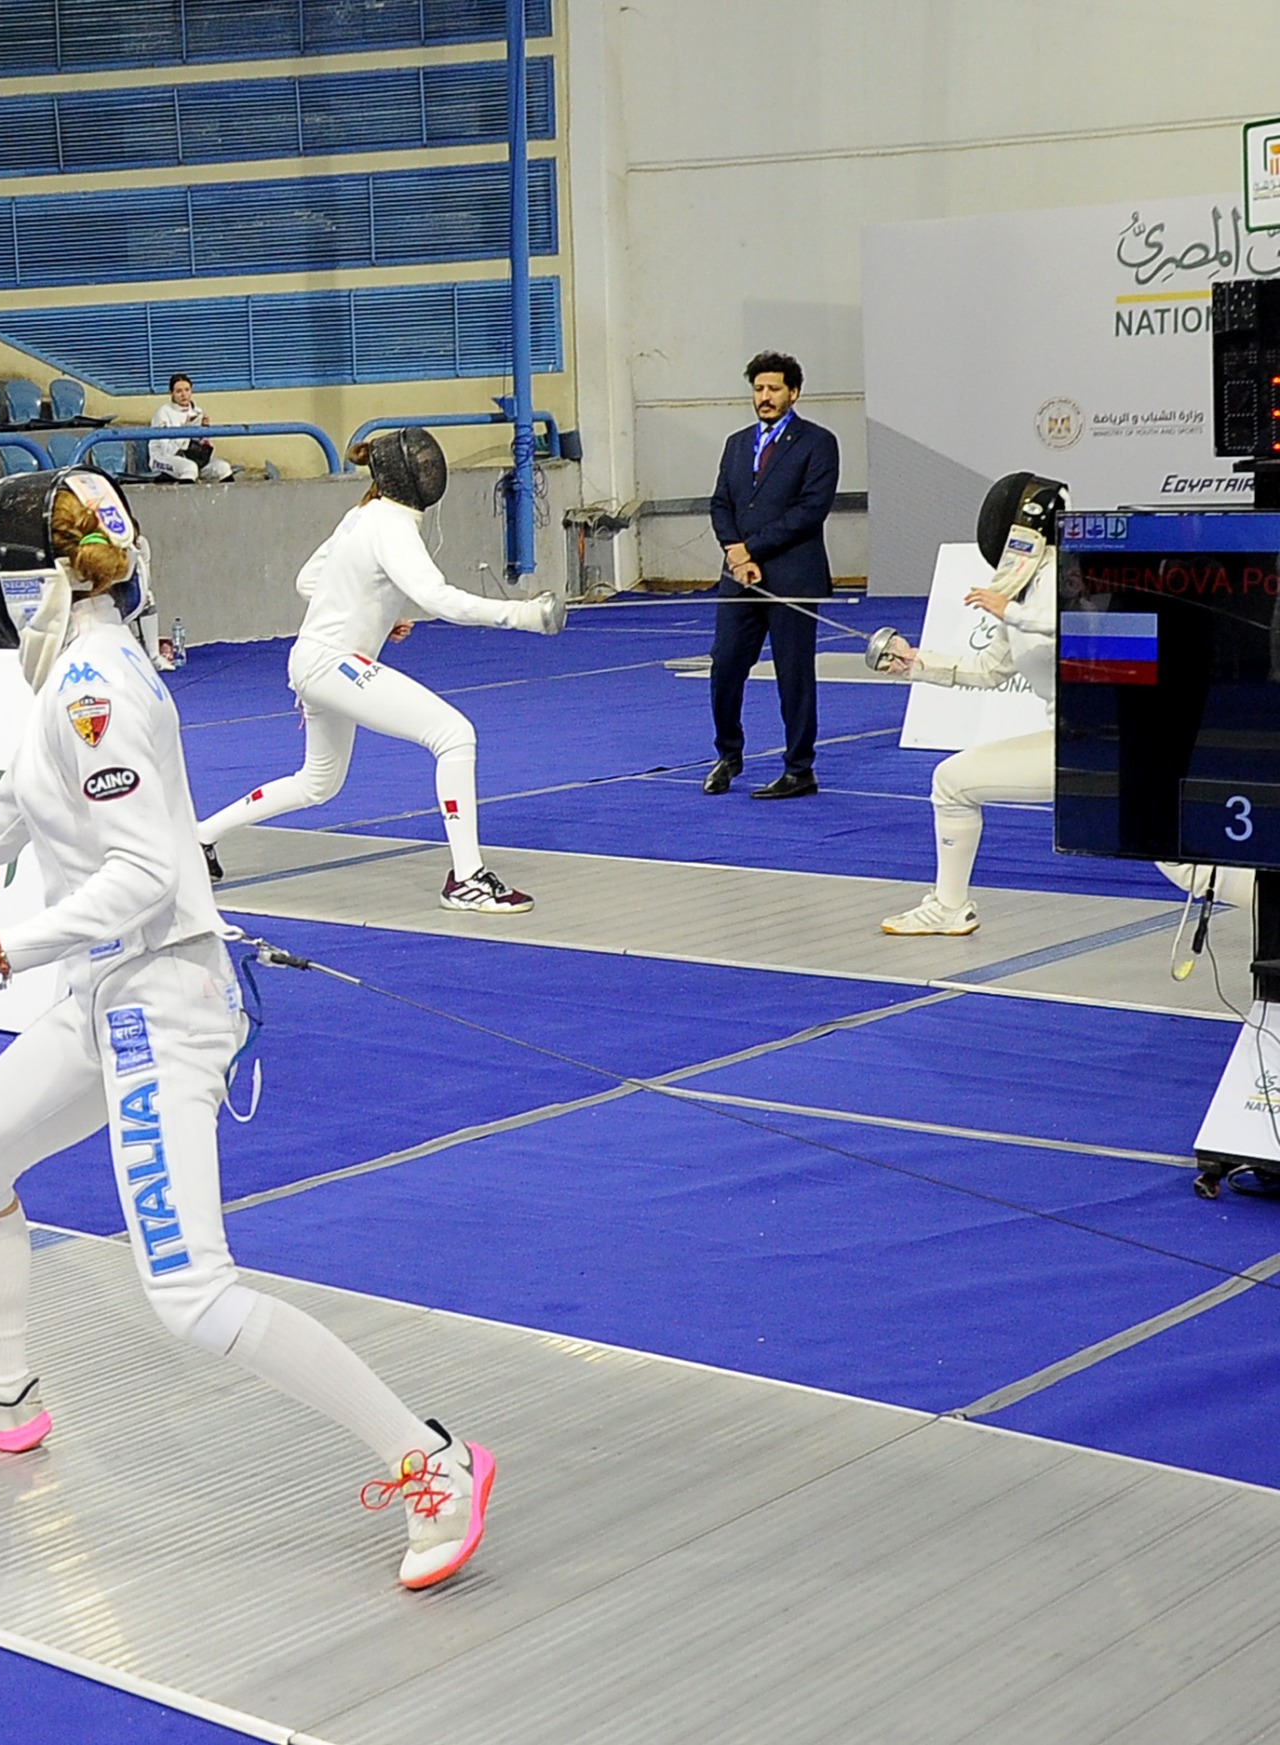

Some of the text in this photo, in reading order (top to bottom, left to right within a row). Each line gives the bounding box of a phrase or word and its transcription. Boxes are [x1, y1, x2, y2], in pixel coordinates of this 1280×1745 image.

[355, 664, 383, 690] FRA
[86, 770, 135, 795] CAINO
[1224, 795, 1254, 841] 3
[120, 1080, 192, 1276] ITALIA
